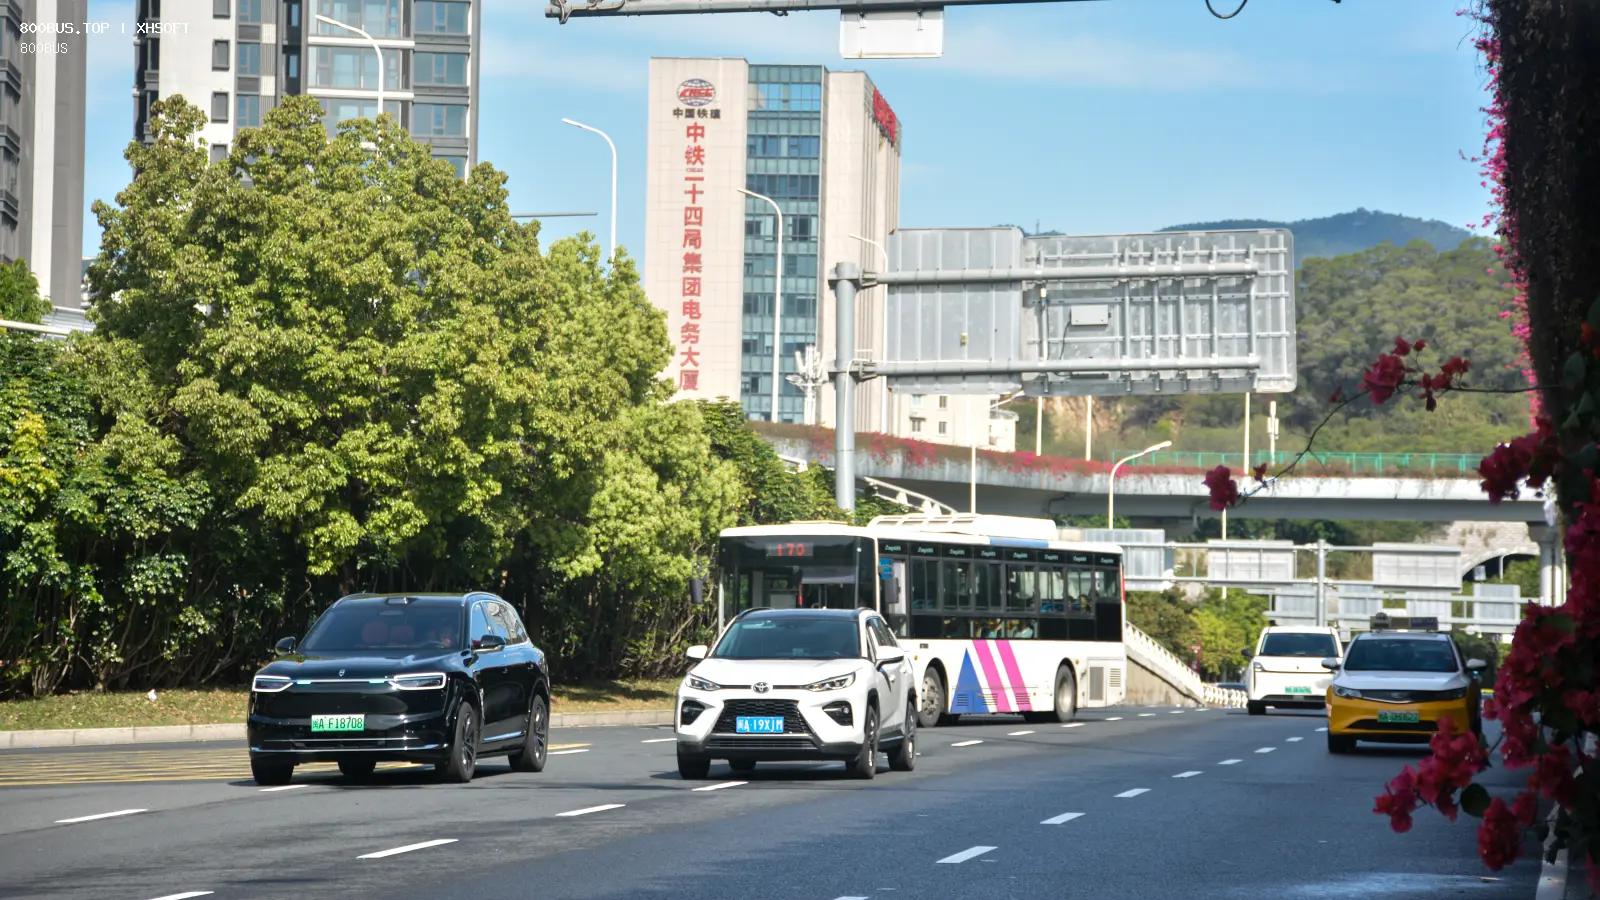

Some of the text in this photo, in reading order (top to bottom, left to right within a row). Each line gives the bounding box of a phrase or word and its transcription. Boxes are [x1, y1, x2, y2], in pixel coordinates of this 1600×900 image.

[679, 121, 705, 391] 中铁二十四局集团电务大厦
[777, 543, 805, 557] 170
